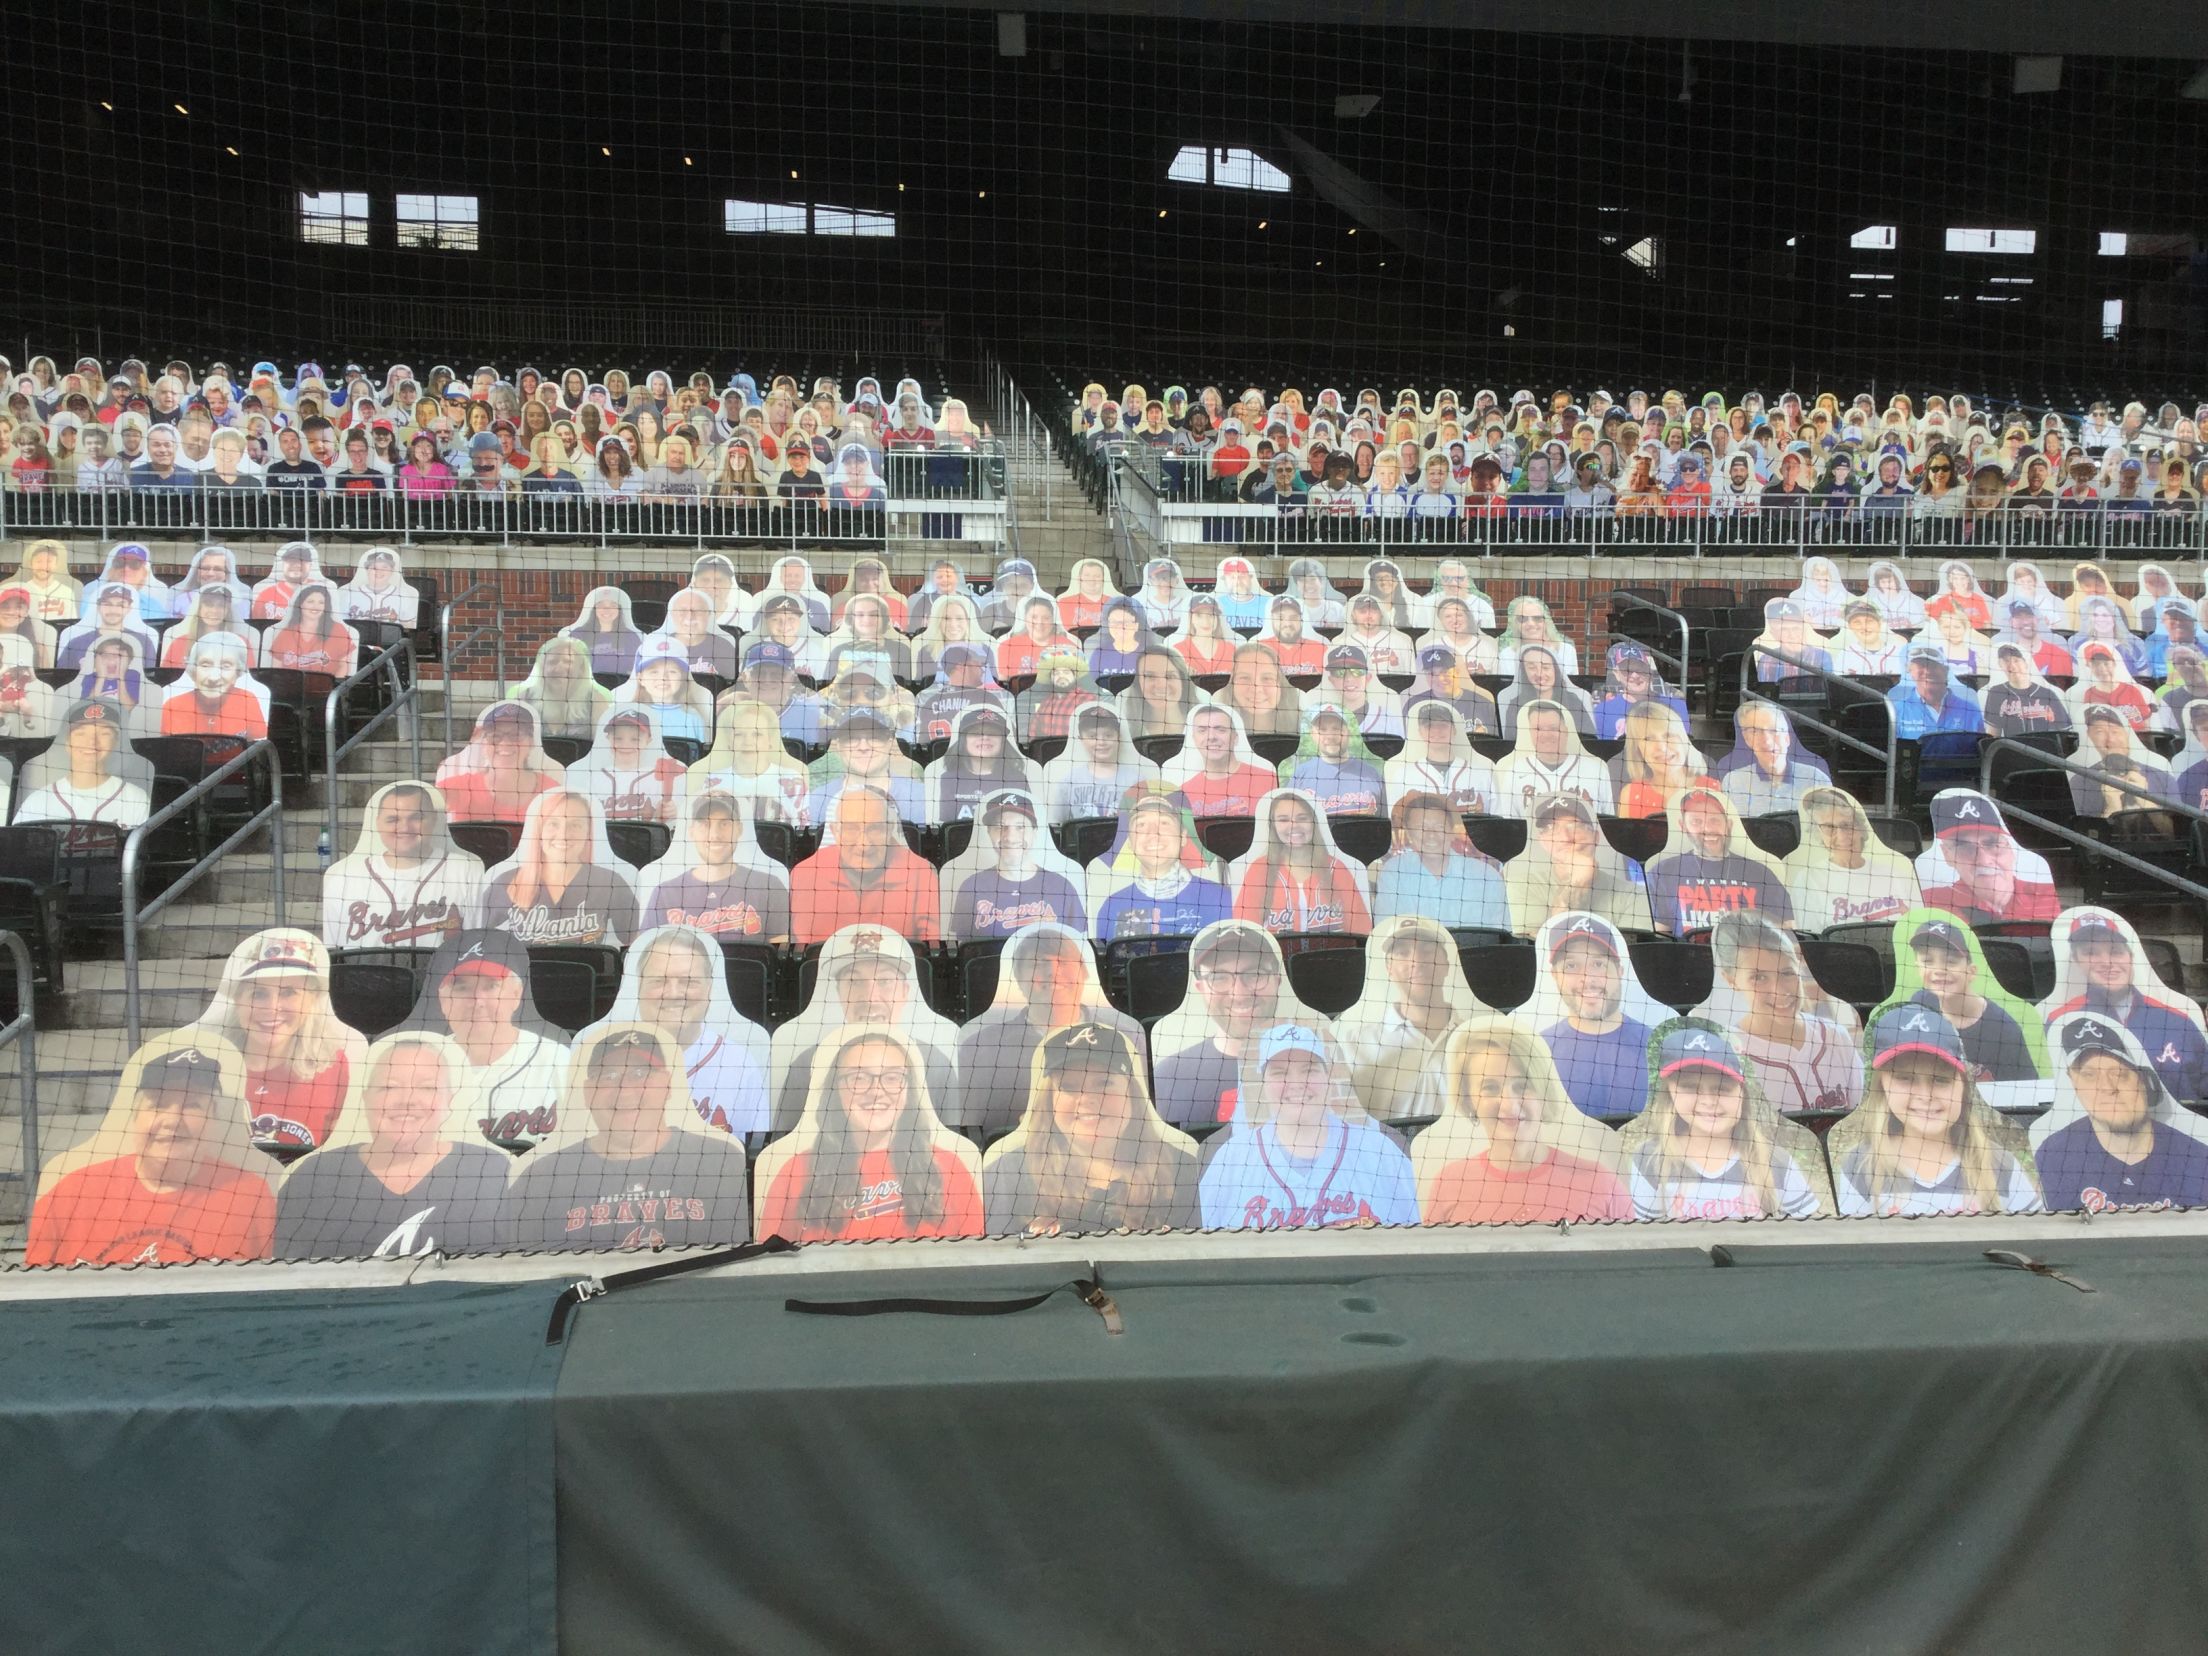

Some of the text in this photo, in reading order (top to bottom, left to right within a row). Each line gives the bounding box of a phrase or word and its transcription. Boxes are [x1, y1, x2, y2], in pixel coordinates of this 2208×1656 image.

[1227, 616, 1263, 627] RAVES
[999, 794, 1018, 806] A
[1547, 797, 1568, 809] A
[1955, 800, 1980, 819] A
[1678, 885, 1758, 912] PARTY
[345, 895, 448, 943] Braves
[974, 898, 1048, 930] Braves
[1832, 896, 1897, 923] Braves
[1568, 917, 1594, 933] A
[1928, 923, 1946, 934] A
[458, 941, 484, 961] A
[1900, 1012, 1929, 1033] A
[2074, 1020, 2103, 1039] A
[1066, 1027, 1097, 1046] A
[1276, 1026, 1300, 1041] A
[1684, 1034, 1710, 1051] A
[167, 1049, 199, 1064] A
[2156, 1042, 2180, 1063] A
[565, 1198, 705, 1232] BRAVES
[133, 1241, 158, 1263] A
